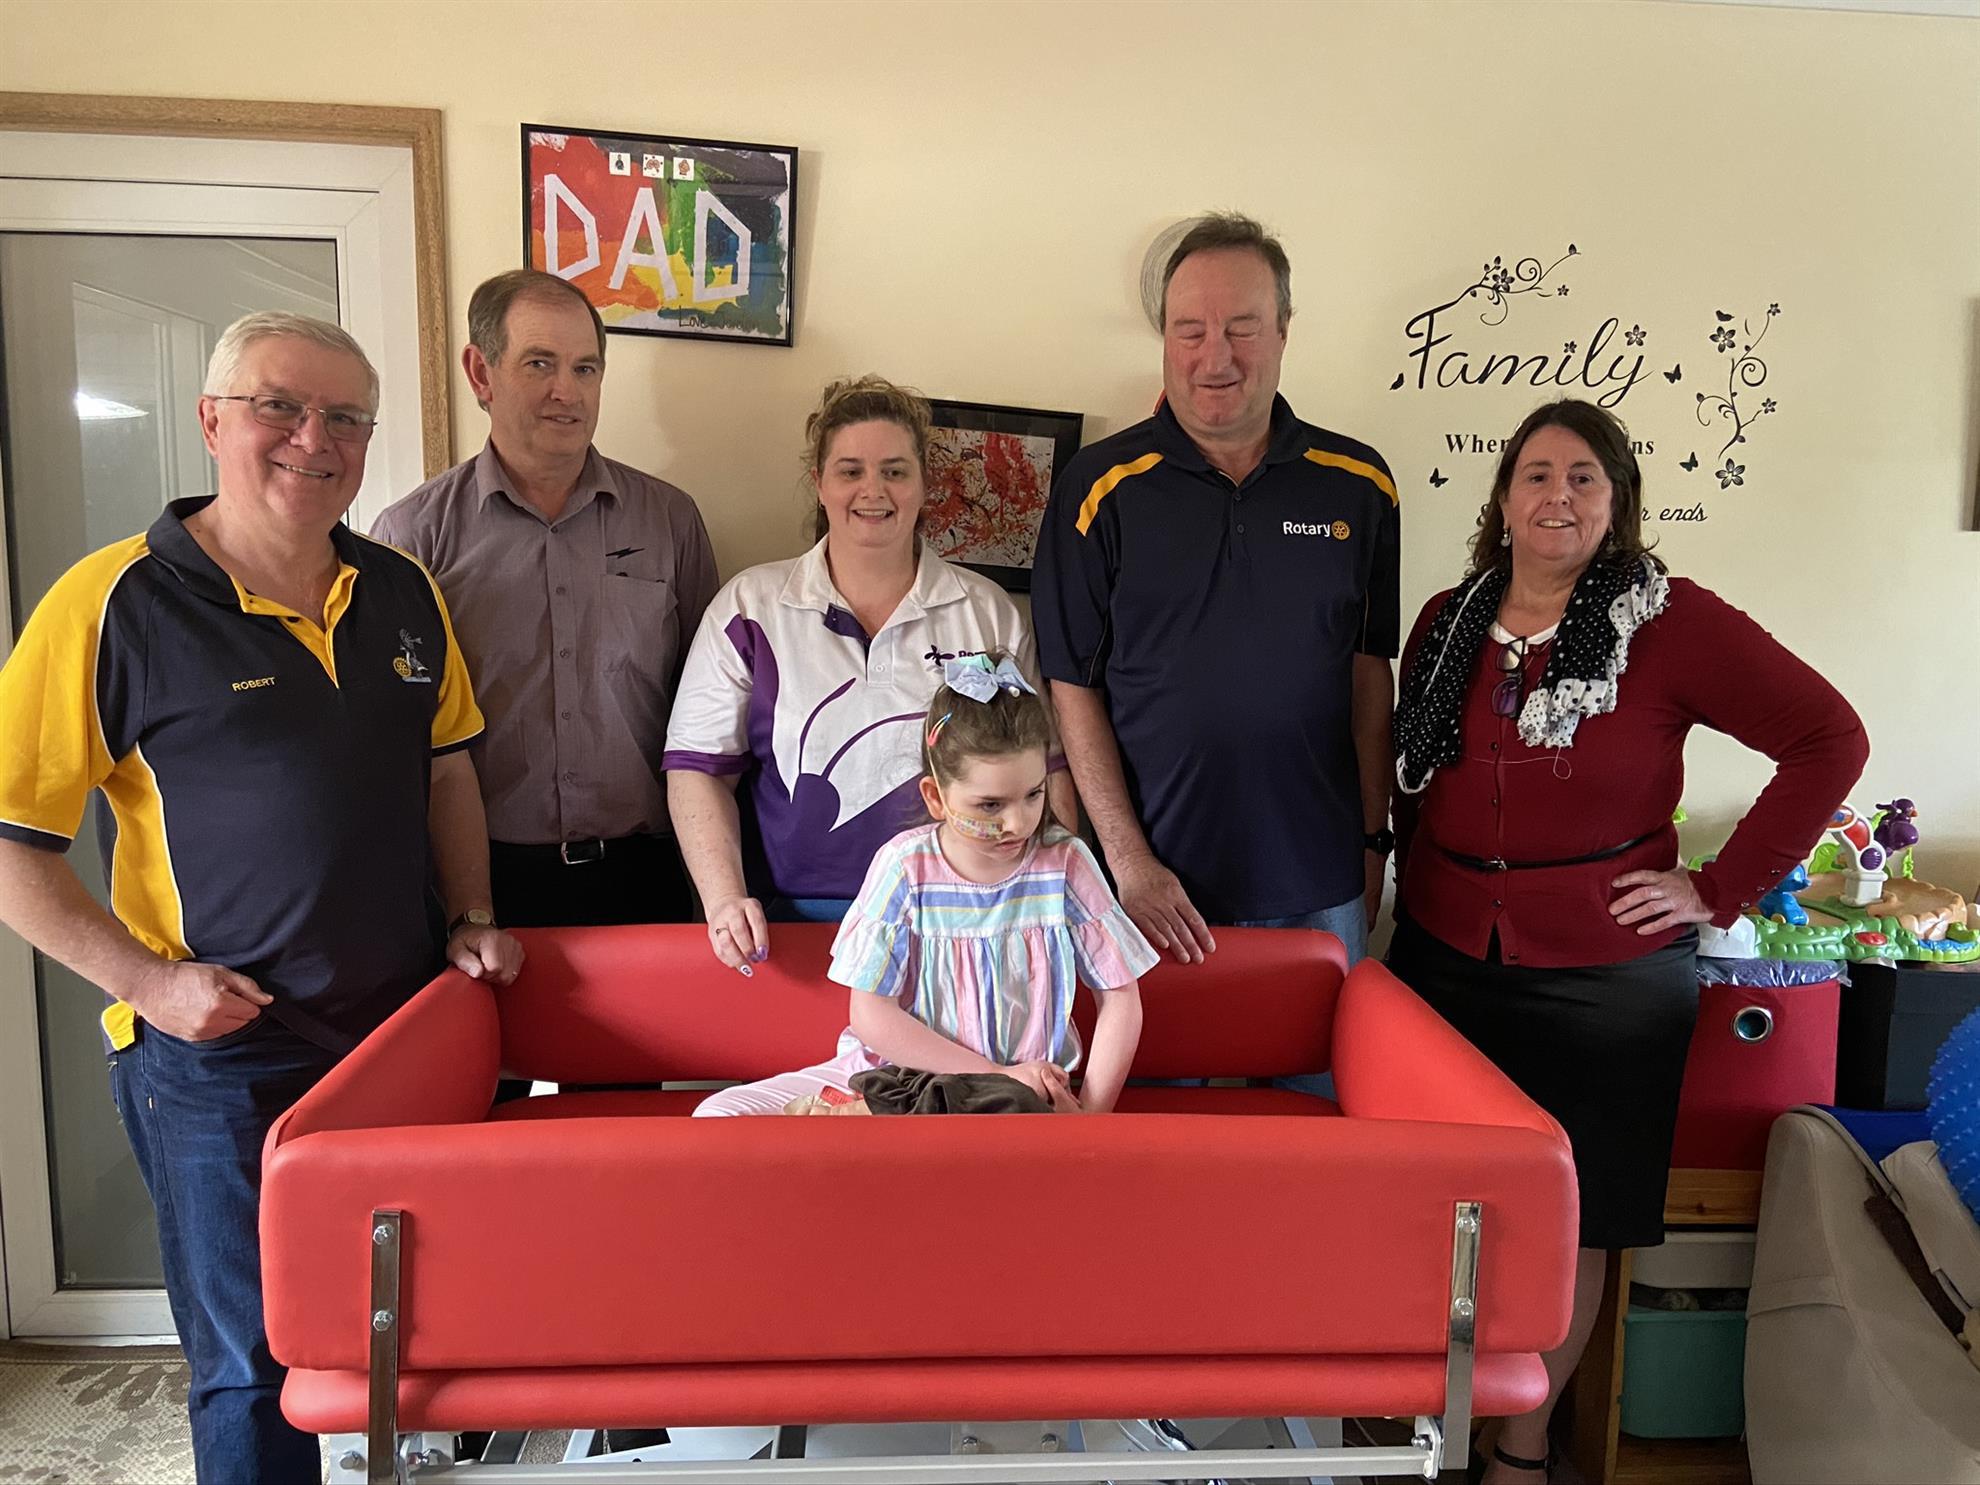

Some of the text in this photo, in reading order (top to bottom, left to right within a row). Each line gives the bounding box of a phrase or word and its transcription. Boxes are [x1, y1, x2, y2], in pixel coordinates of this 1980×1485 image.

[544, 173, 752, 303] DAD
[1405, 299, 1655, 408] Family
[1445, 434, 1510, 453] Wher
[1660, 503, 1708, 521] ends
[1282, 521, 1331, 537] Rotary
[231, 676, 275, 692] ROBERT
